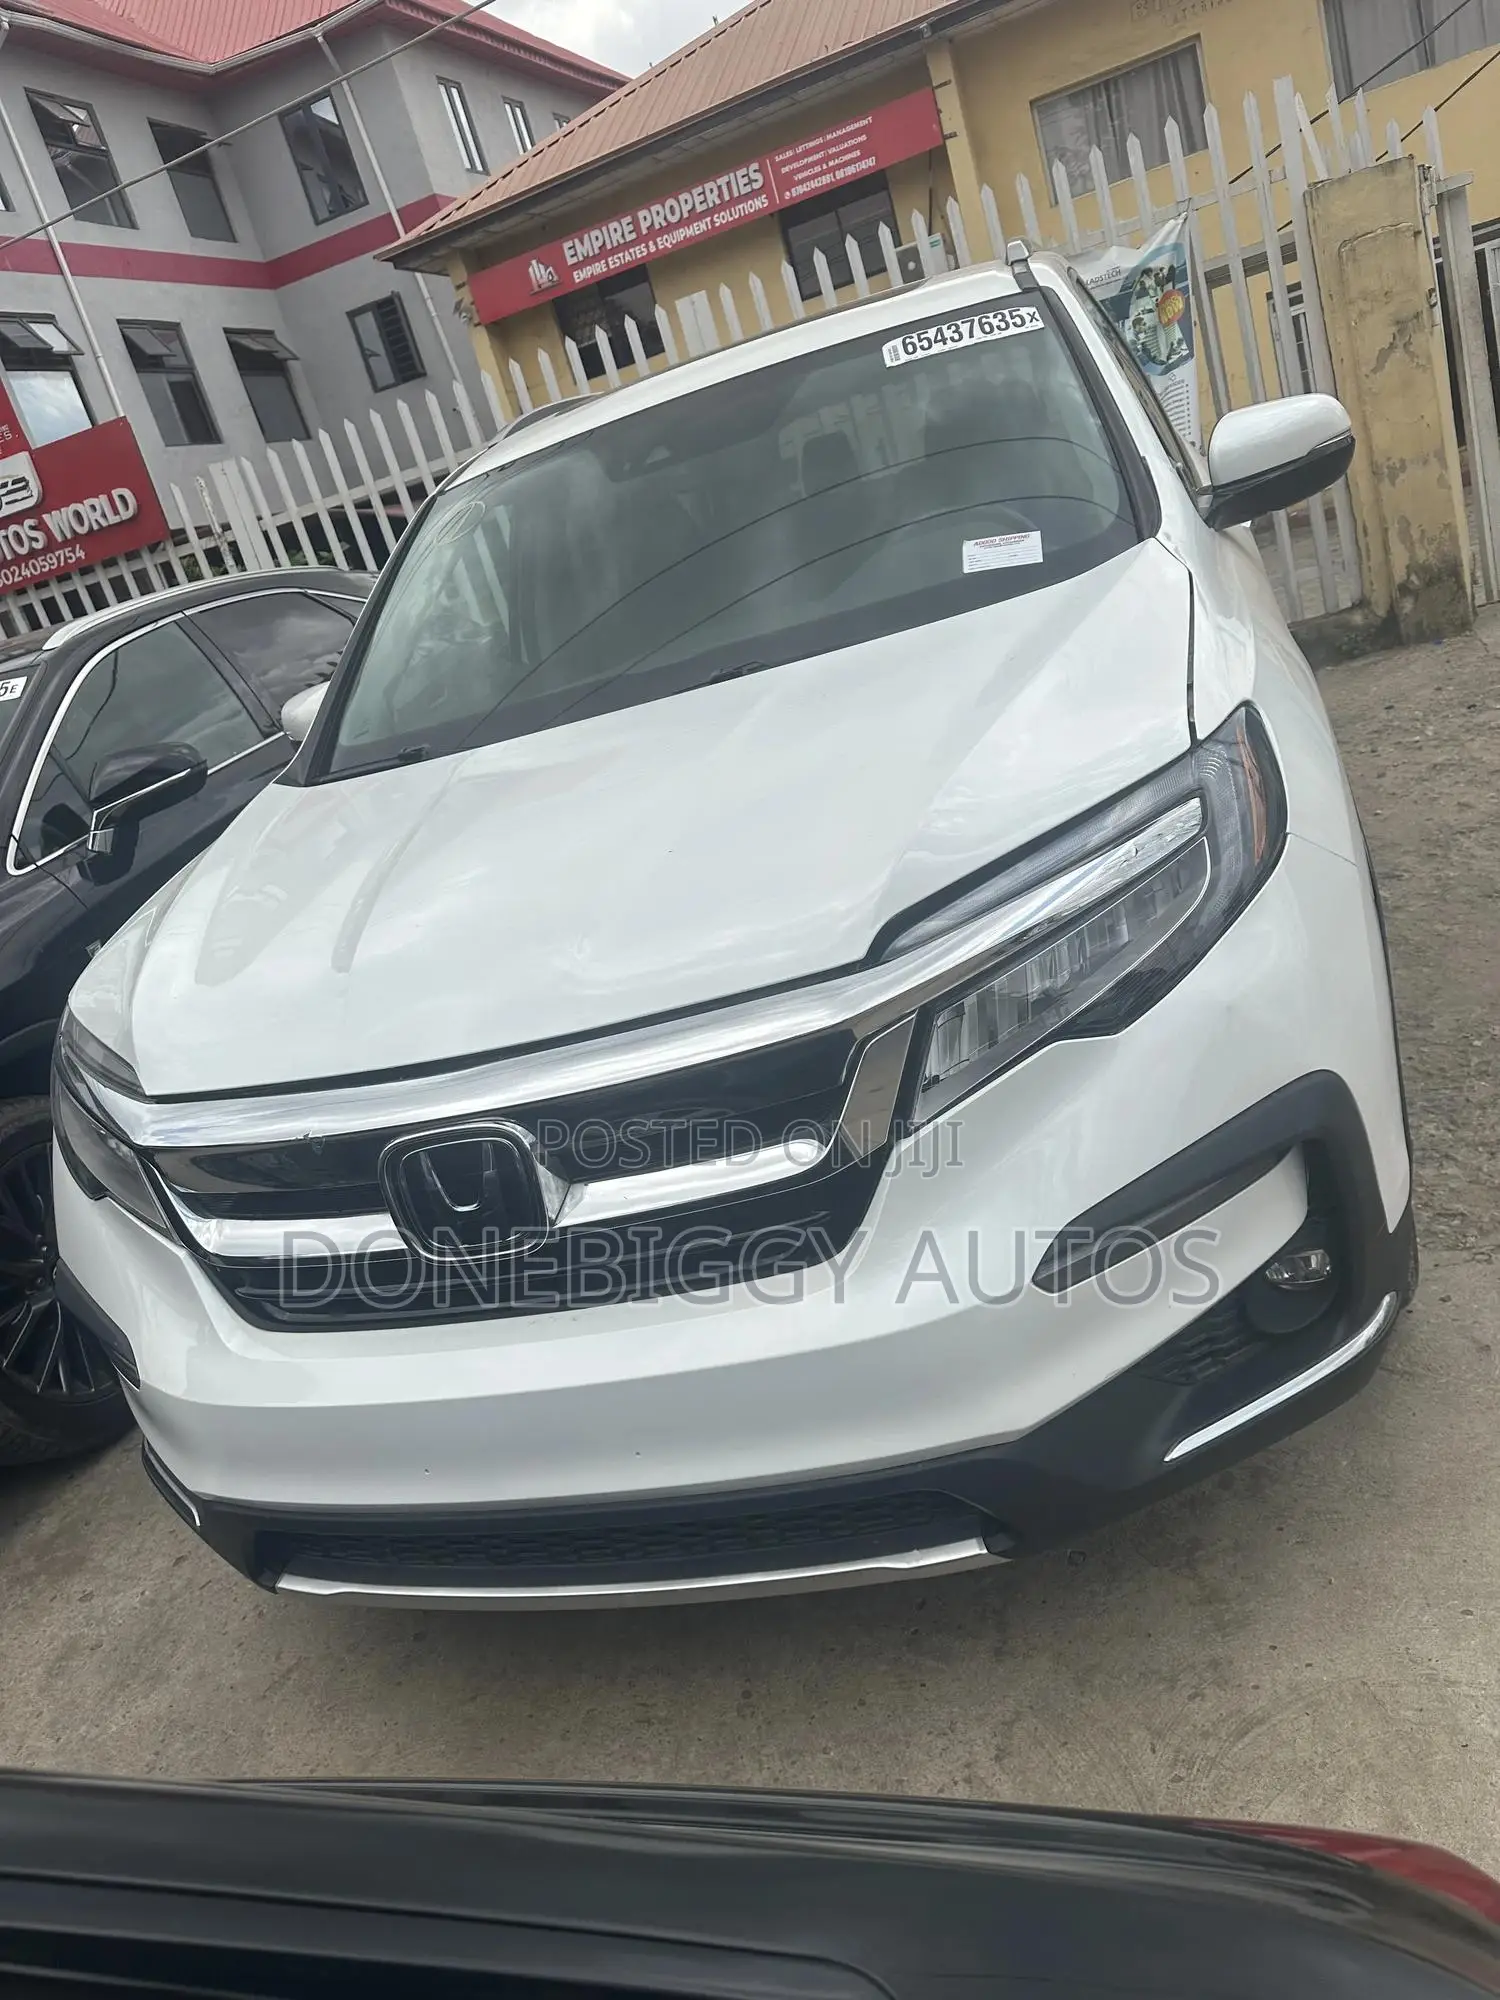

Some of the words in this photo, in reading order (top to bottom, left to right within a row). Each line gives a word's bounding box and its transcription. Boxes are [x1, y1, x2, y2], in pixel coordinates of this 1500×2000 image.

[781, 150, 825, 174] DEVELOPMENT
[827, 133, 868, 155] VALUATIONS
[826, 115, 873, 141] MANAGEMENT
[562, 215, 638, 266] EMPIRE
[637, 161, 765, 236] PROPERTIES
[573, 259, 608, 284] EMPIRE
[608, 243, 648, 269] ESTATES
[649, 240, 657, 253] &
[656, 215, 713, 250] EQUIPMENT
[713, 194, 769, 228] SOLUTIONS
[42, 487, 139, 543] WORLD
